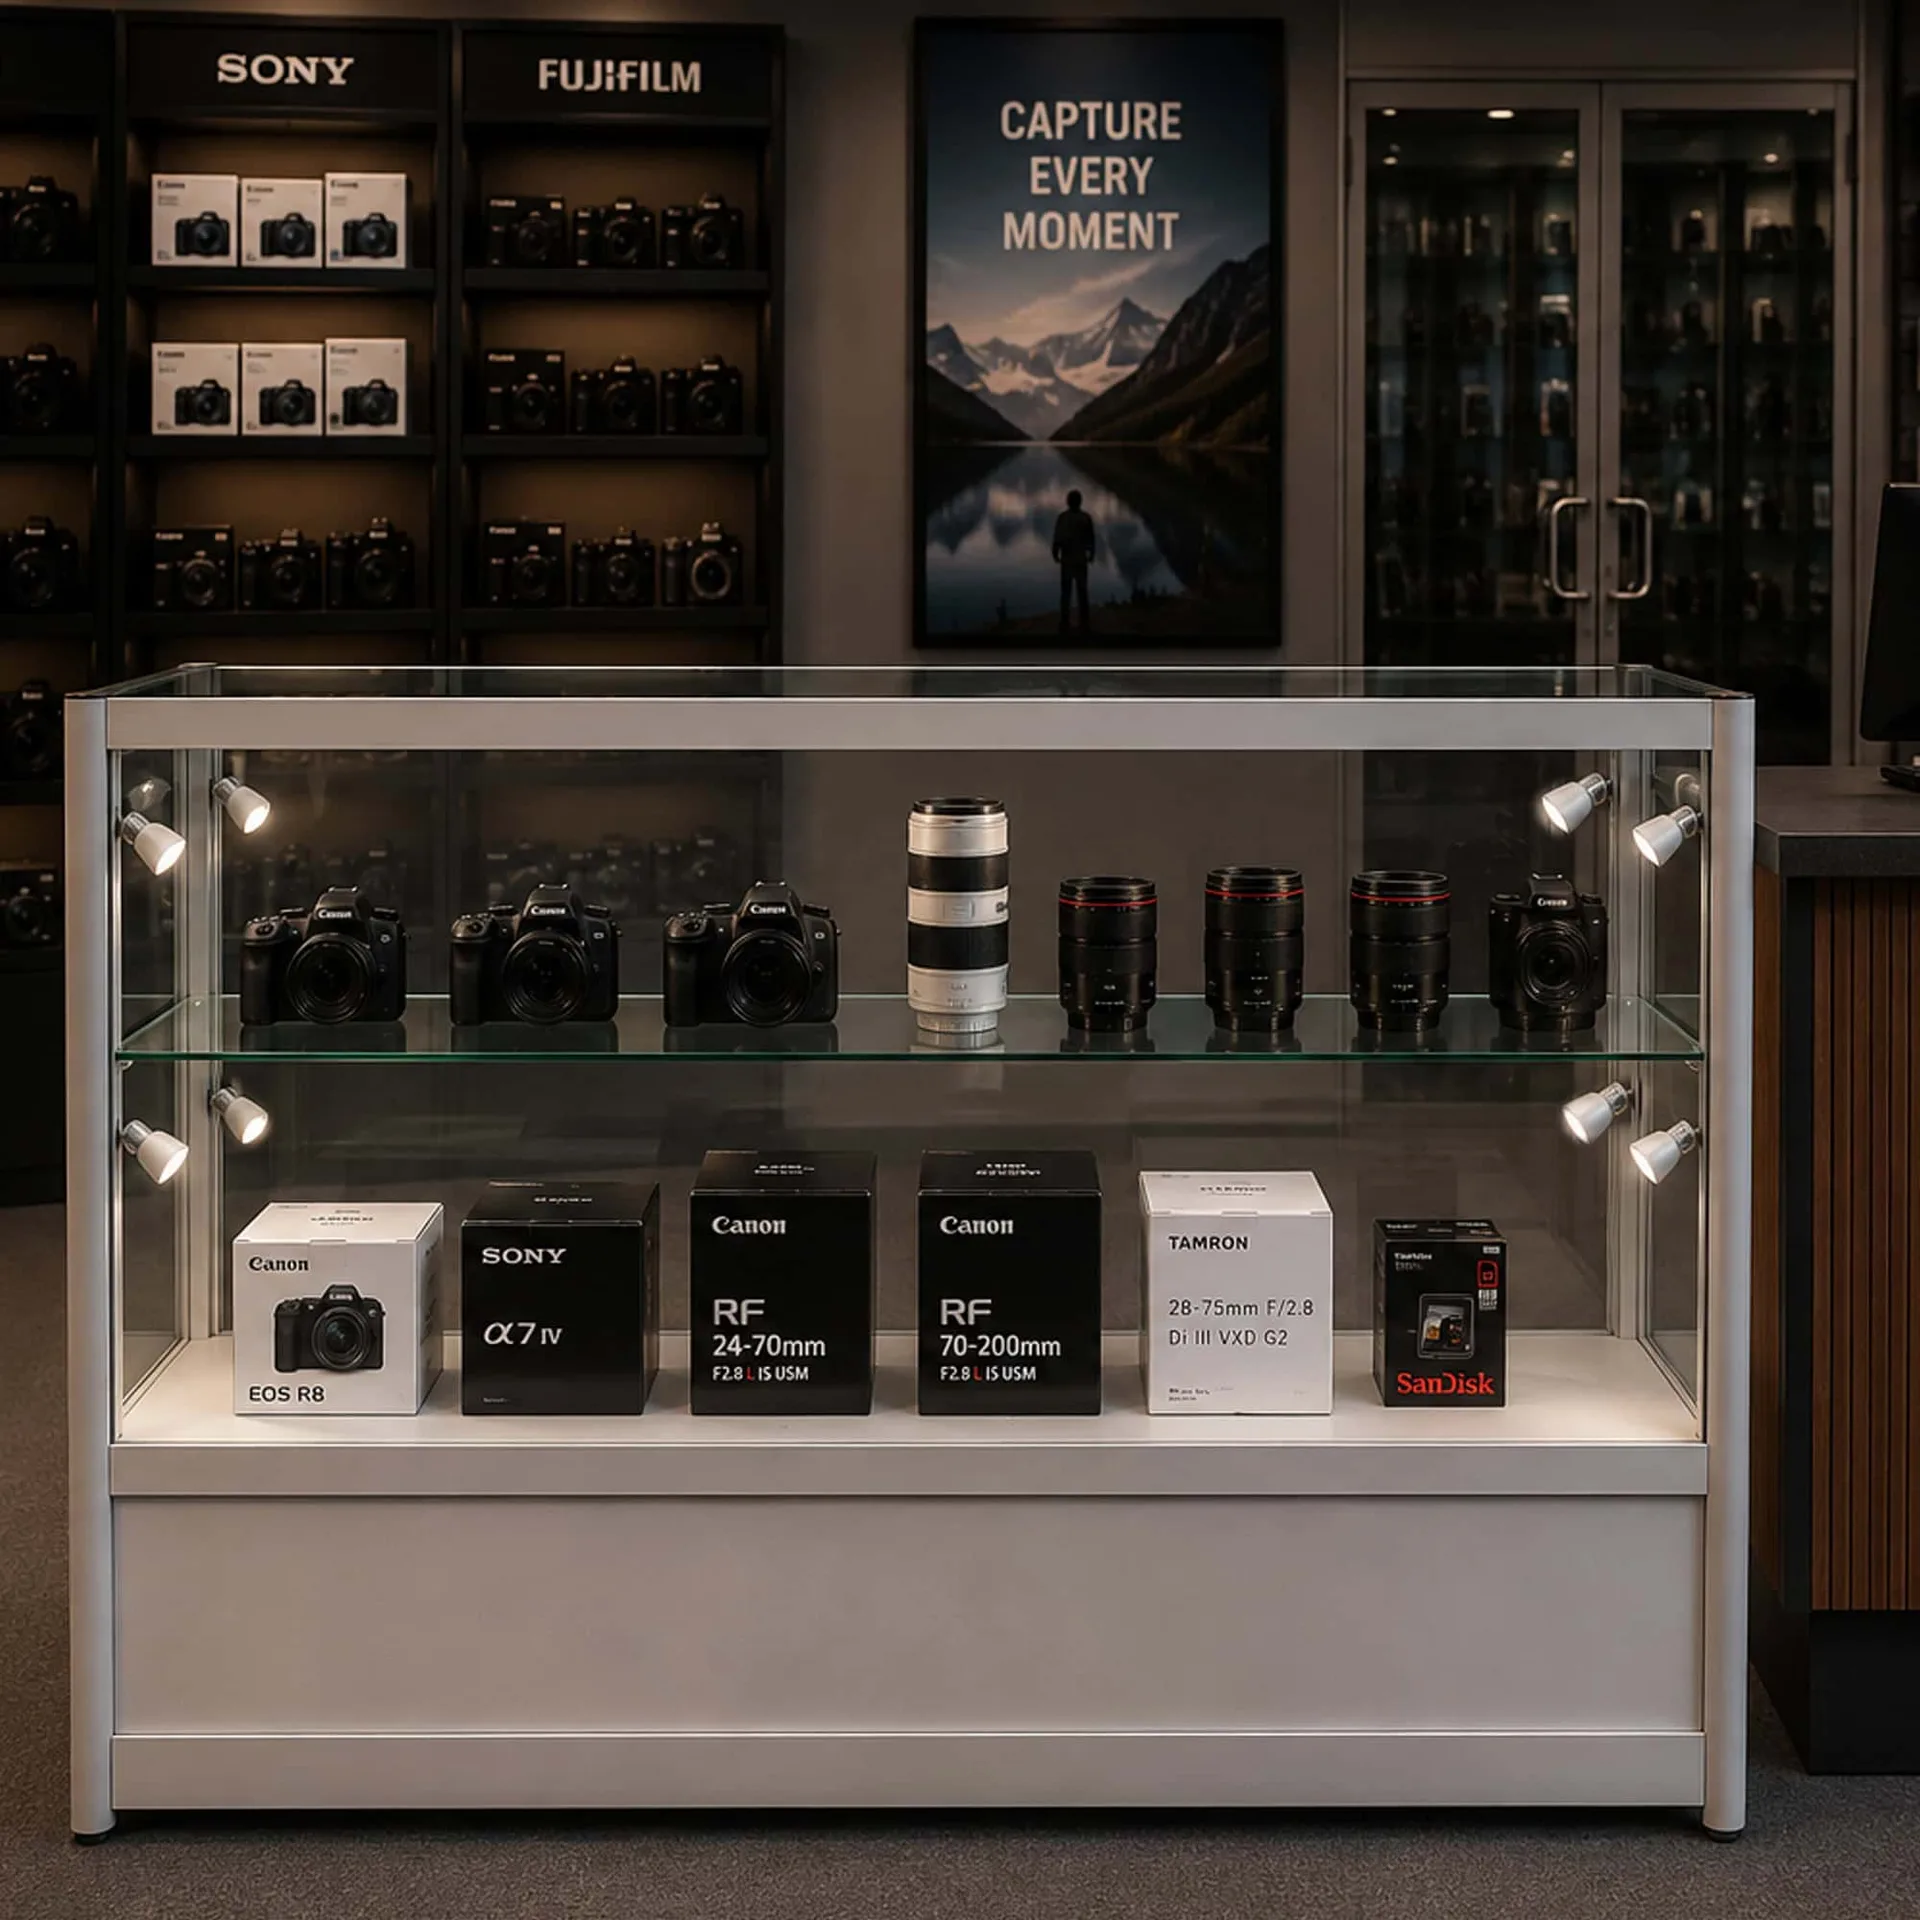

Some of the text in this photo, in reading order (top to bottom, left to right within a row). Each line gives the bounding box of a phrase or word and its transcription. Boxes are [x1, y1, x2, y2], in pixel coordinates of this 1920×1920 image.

[217, 53, 354, 85] SONY
[539, 59, 701, 93] FUJIFILM
[1001, 101, 1181, 140] CAPTURE
[1031, 156, 1153, 195] EVERY
[1004, 211, 1178, 250] MOMENT
[712, 1215, 786, 1235] Canon
[939, 1215, 1014, 1235] Canon
[1168, 1235, 1248, 1250] TAMRON
[248, 1256, 309, 1271] Canon
[482, 1247, 567, 1264] SONY
[714, 1298, 765, 1326] RF
[941, 1298, 992, 1326] RF
[1169, 1299, 1314, 1317] 28-75mm F/2.8
[713, 1334, 826, 1357] 24-70mm
[940, 1334, 1061, 1357] 70-200mm
[1169, 1329, 1288, 1346] Di III VXD G2
[712, 1365, 809, 1381] F2.8 L IS USM
[940, 1365, 1036, 1381] F2.8 L IS USM
[1397, 1372, 1494, 1395] SanDisk
[249, 1385, 325, 1403] EOS R8
